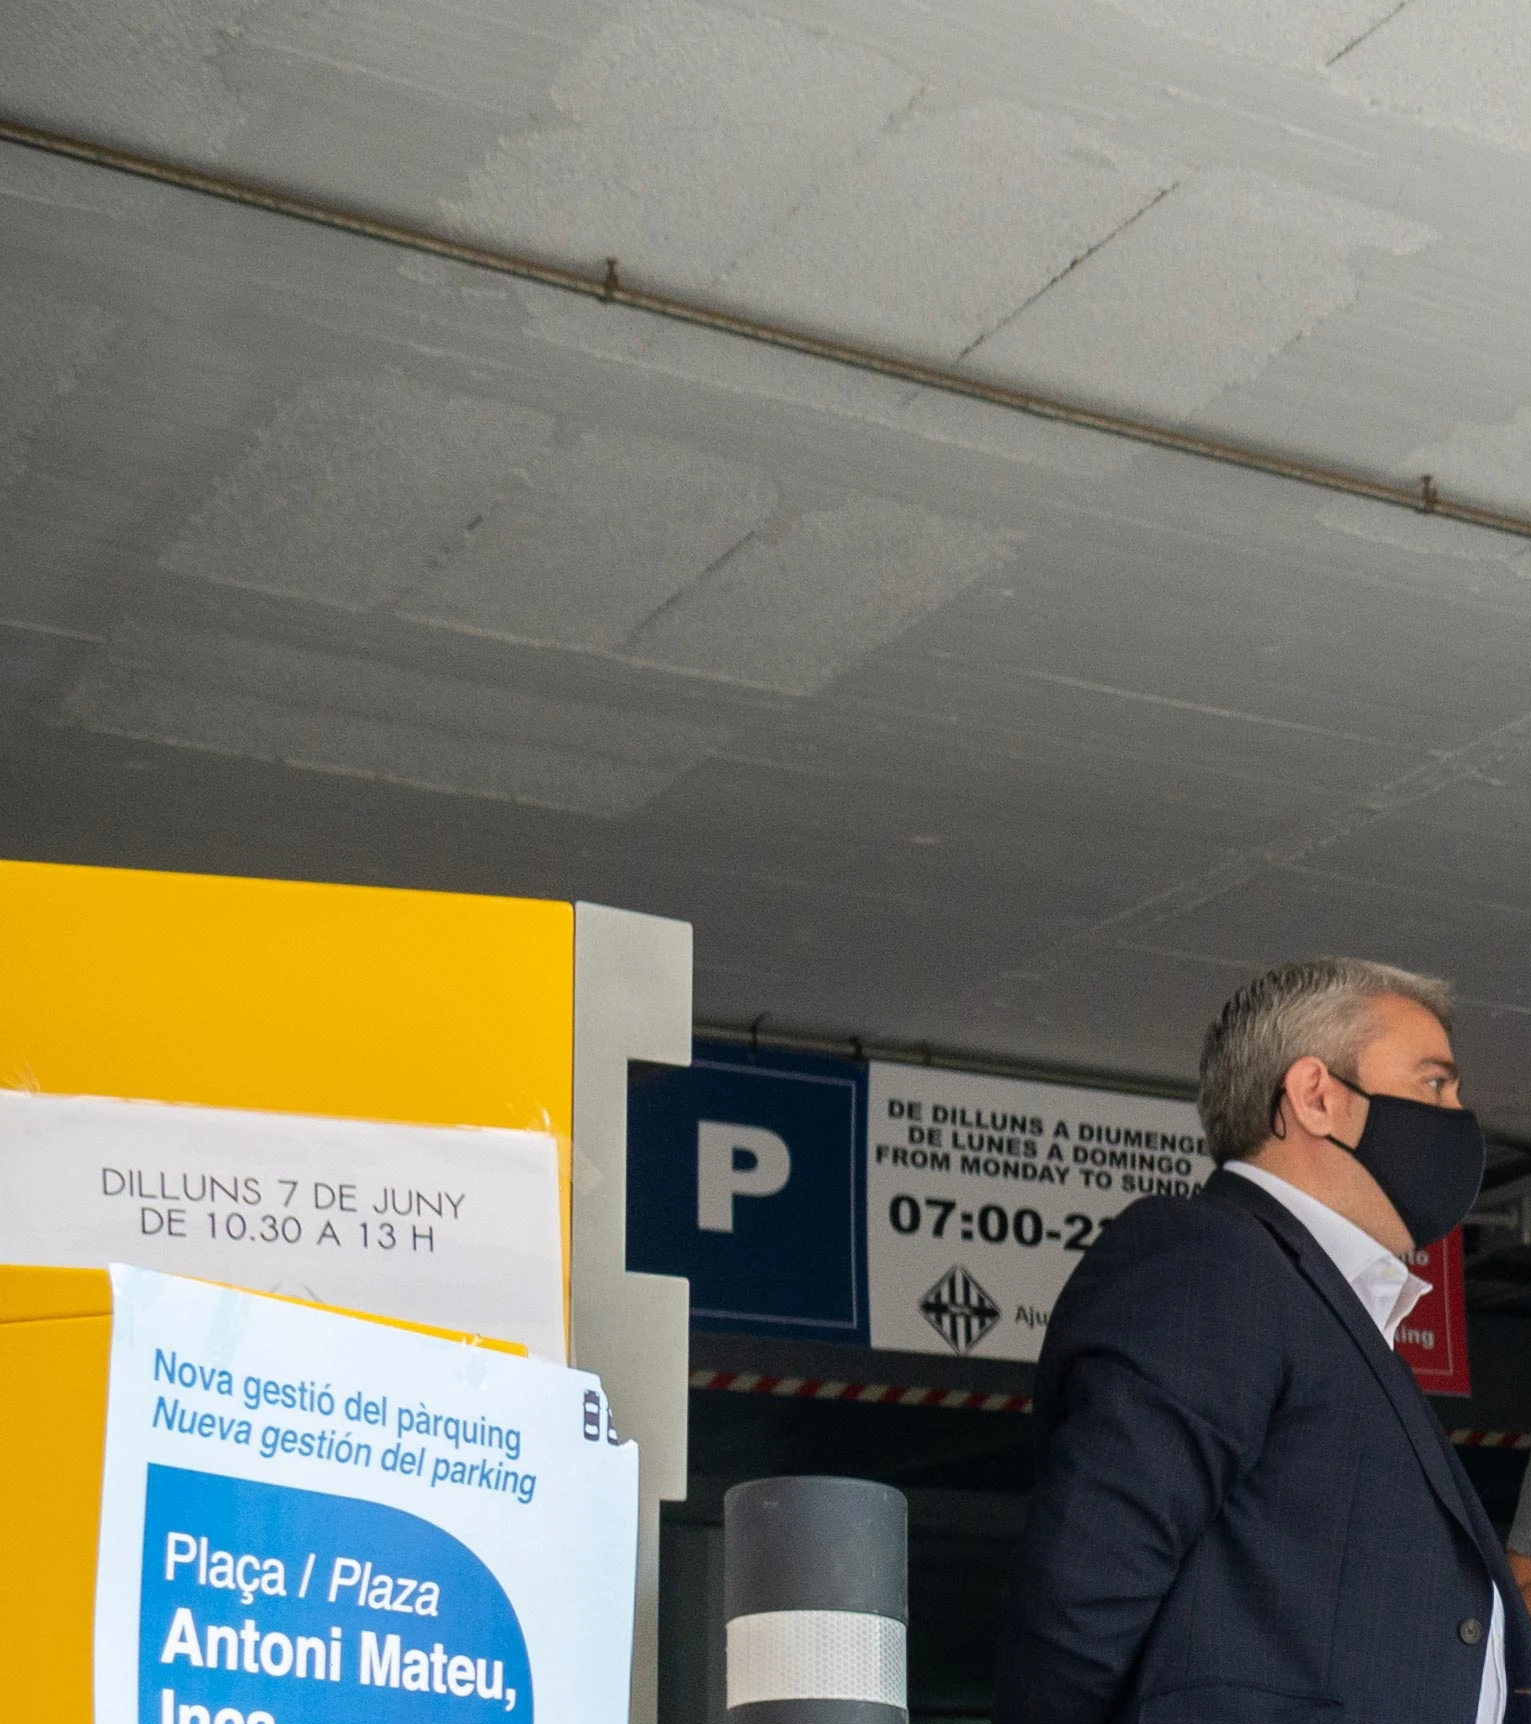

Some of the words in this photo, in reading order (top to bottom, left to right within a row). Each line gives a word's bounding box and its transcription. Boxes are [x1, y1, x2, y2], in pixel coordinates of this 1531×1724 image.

[888, 1098, 923, 1122] DE
[931, 1103, 1044, 1137] DILLUNS
[1053, 1120, 1070, 1140] A
[698, 1119, 791, 1233] P
[875, 1144, 951, 1172] FROM
[960, 1154, 1071, 1186] MONDAY
[1079, 1168, 1113, 1190] TO
[908, 1125, 943, 1148] DE
[951, 1130, 1038, 1158] LUNES
[1047, 1142, 1064, 1162] A
[1072, 1146, 1192, 1177] DOMINGO
[102, 1167, 262, 1206] DILLUNS
[278, 1179, 298, 1207] 7
[314, 1182, 358, 1213] DE
[372, 1187, 465, 1219] JUNY
[141, 1206, 187, 1238] DE
[209, 1211, 301, 1244] 10.30
[316, 1219, 341, 1246] A
[360, 1221, 396, 1250] 13
[412, 1225, 434, 1252] H
[1394, 1326, 1435, 1350] ing
[154, 1348, 233, 1397] Nova
[243, 1374, 335, 1417] gestió
[345, 1391, 387, 1427] del
[397, 1402, 521, 1461] pàrquing
[152, 1395, 252, 1446] Nueva
[259, 1423, 371, 1468] gestión
[380, 1441, 425, 1478] del
[431, 1456, 537, 1504] parking
[165, 1531, 287, 1605] Plaça
[298, 1553, 316, 1598] /
[328, 1556, 441, 1617] Plaza
[160, 1607, 342, 1682] Antoni
[360, 1630, 517, 1712] Mateu,
